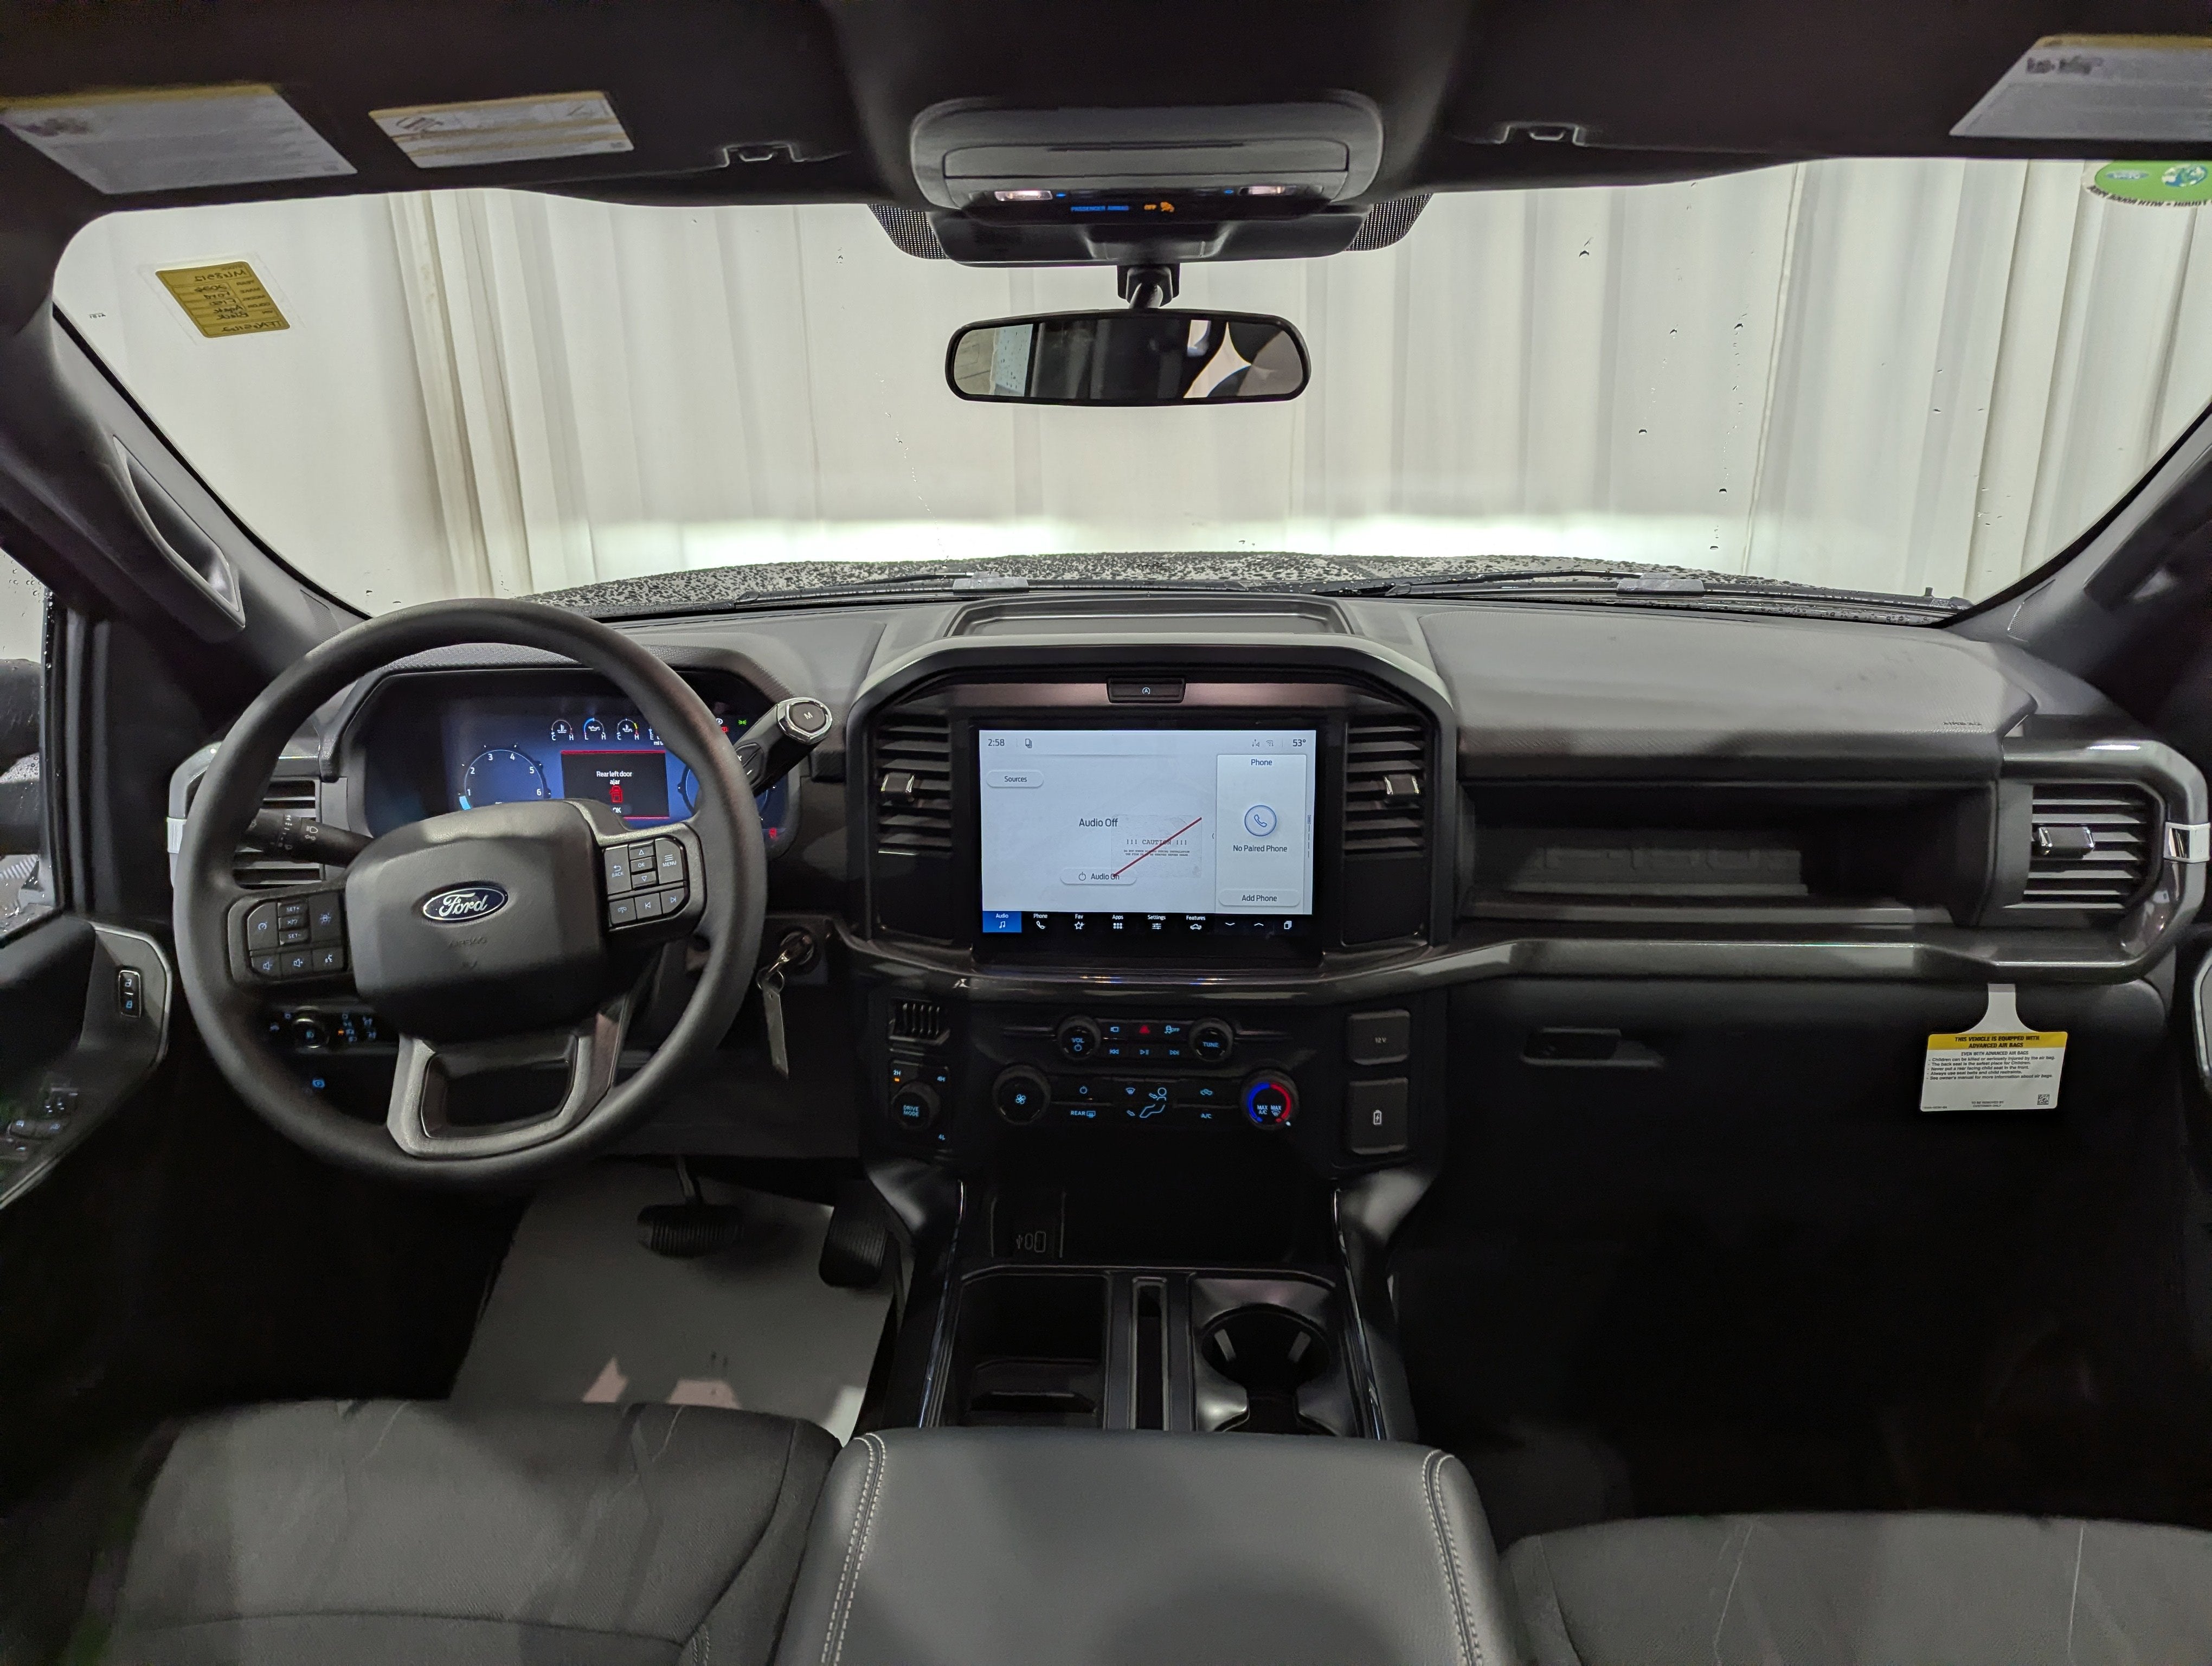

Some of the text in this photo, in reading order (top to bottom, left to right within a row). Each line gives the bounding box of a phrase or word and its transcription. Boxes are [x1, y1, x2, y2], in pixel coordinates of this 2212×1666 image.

[1079, 818, 1118, 827] Audio Off
[439, 892, 488, 917] Ford
